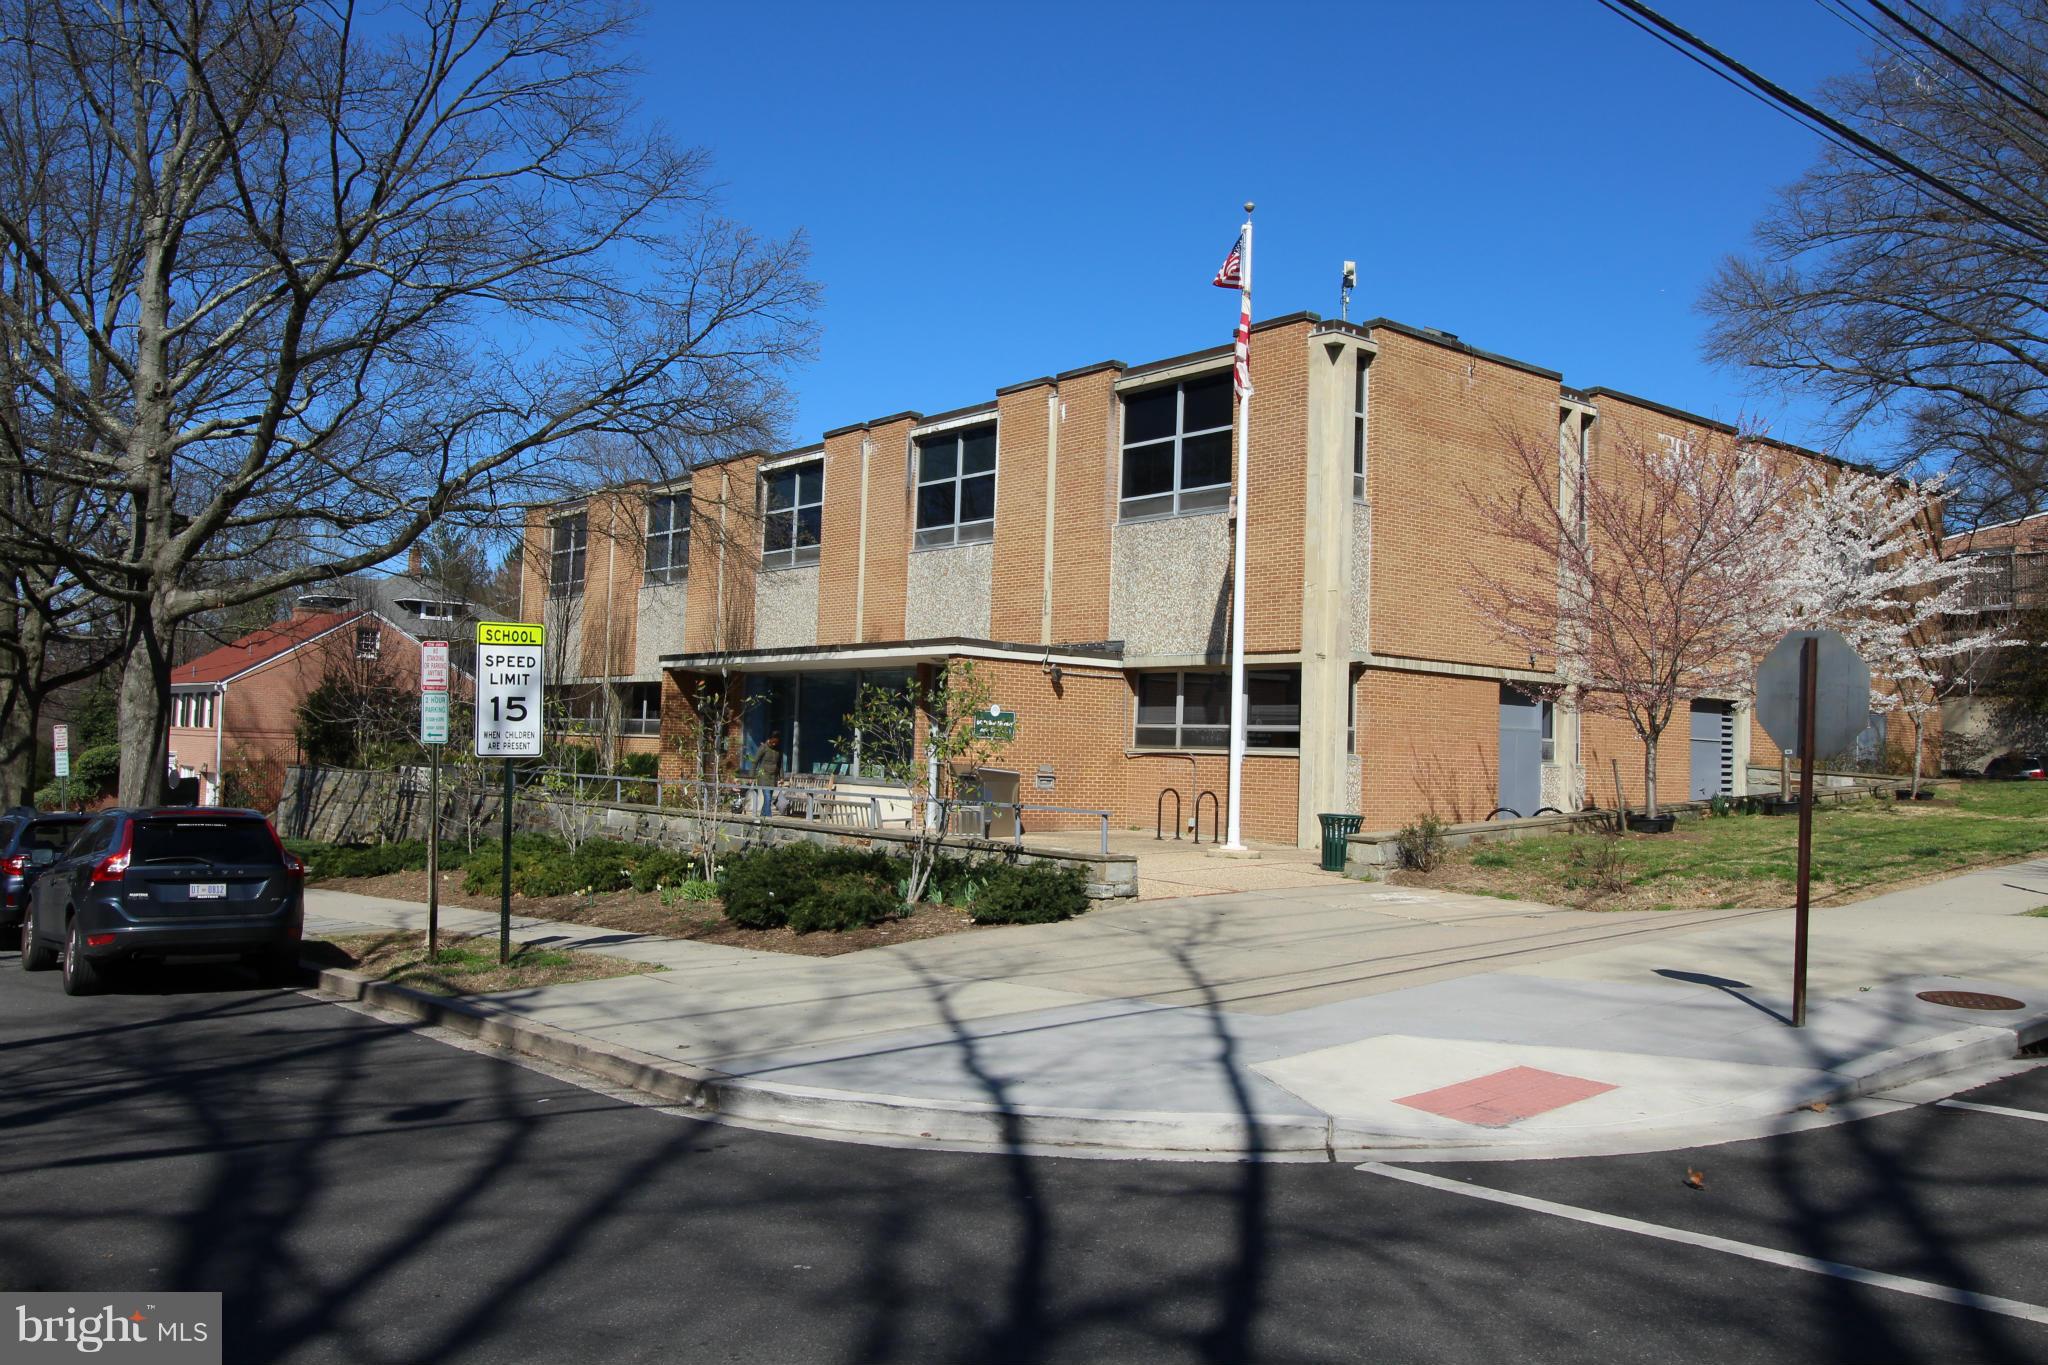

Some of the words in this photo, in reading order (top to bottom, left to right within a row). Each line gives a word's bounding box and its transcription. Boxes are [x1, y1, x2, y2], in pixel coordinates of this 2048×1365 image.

[486, 629, 536, 643] SCHOOL
[485, 655, 536, 668] SPEED
[490, 673, 530, 686] LIMIT
[490, 696, 528, 722] 15
[484, 731, 501, 739] WHEN
[505, 731, 535, 739] CHILDREN
[488, 742, 500, 750] ARE
[503, 742, 531, 750] PRESENT
